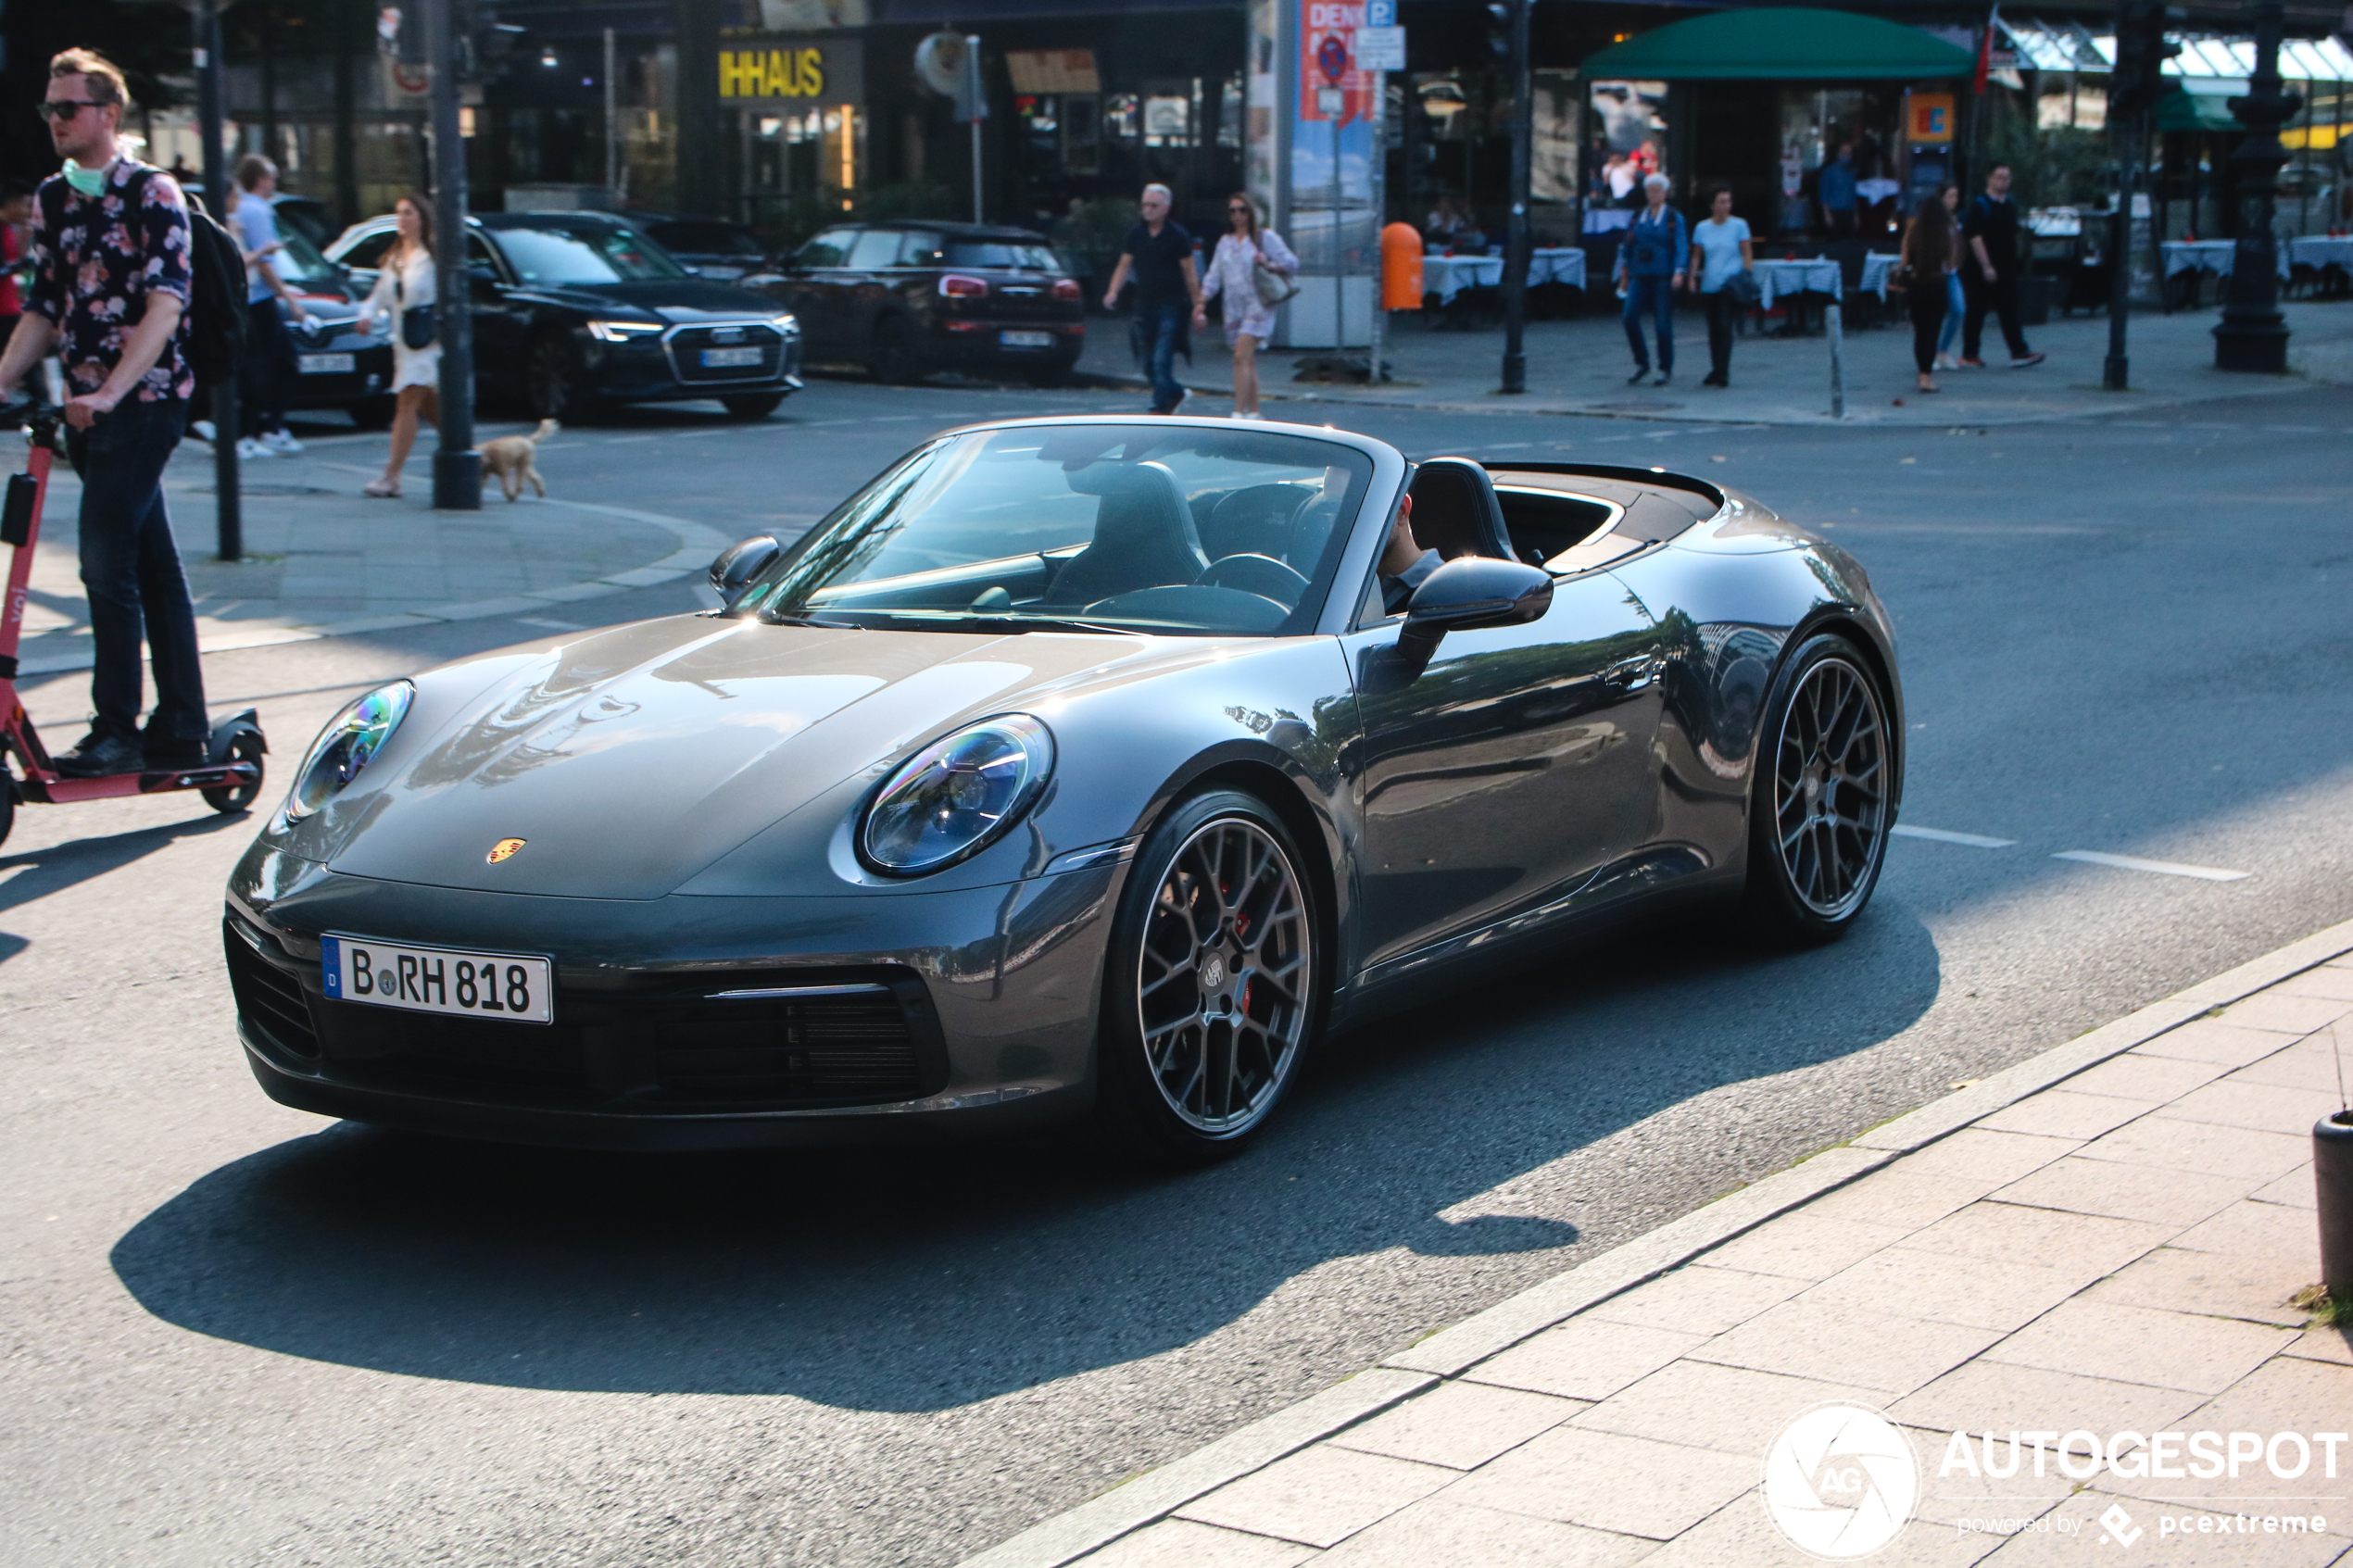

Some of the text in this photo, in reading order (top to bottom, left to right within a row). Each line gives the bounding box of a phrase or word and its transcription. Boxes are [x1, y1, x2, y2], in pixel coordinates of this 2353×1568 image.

[1370, 2, 1390, 24] P
[328, 973, 336, 986] D
[352, 948, 530, 1013] B RH 818
